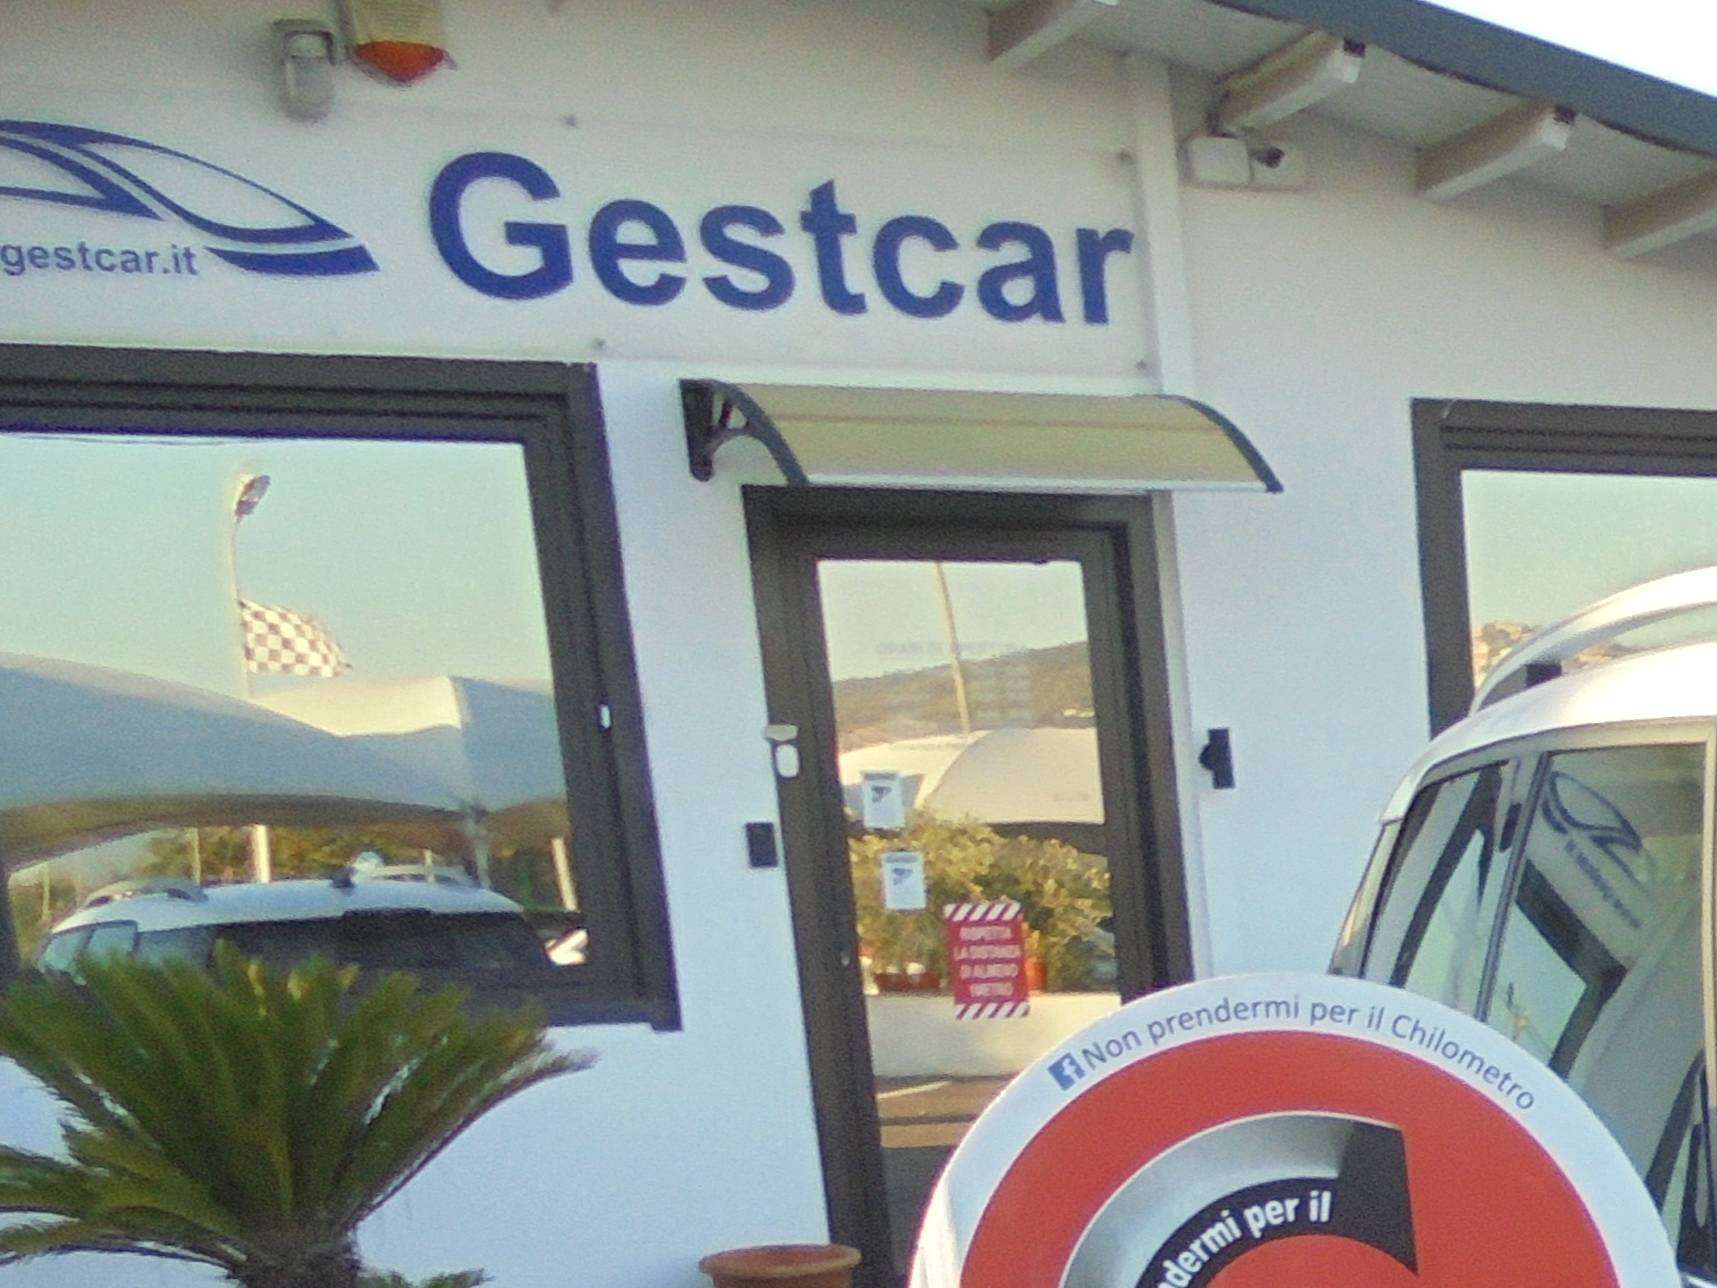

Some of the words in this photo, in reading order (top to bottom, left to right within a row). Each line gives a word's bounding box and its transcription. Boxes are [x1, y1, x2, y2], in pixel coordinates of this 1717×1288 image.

[0, 241, 199, 276] gestcar.it
[427, 150, 1133, 327] Gestcar
[1082, 1030, 1141, 1070] Non
[1147, 995, 1300, 1045] prendermi
[1311, 1001, 1358, 1025] per
[1366, 1006, 1385, 1030] il
[1391, 1014, 1535, 1110] Chilometro
[1243, 1198, 1301, 1238] per
[1309, 1191, 1331, 1222] il
